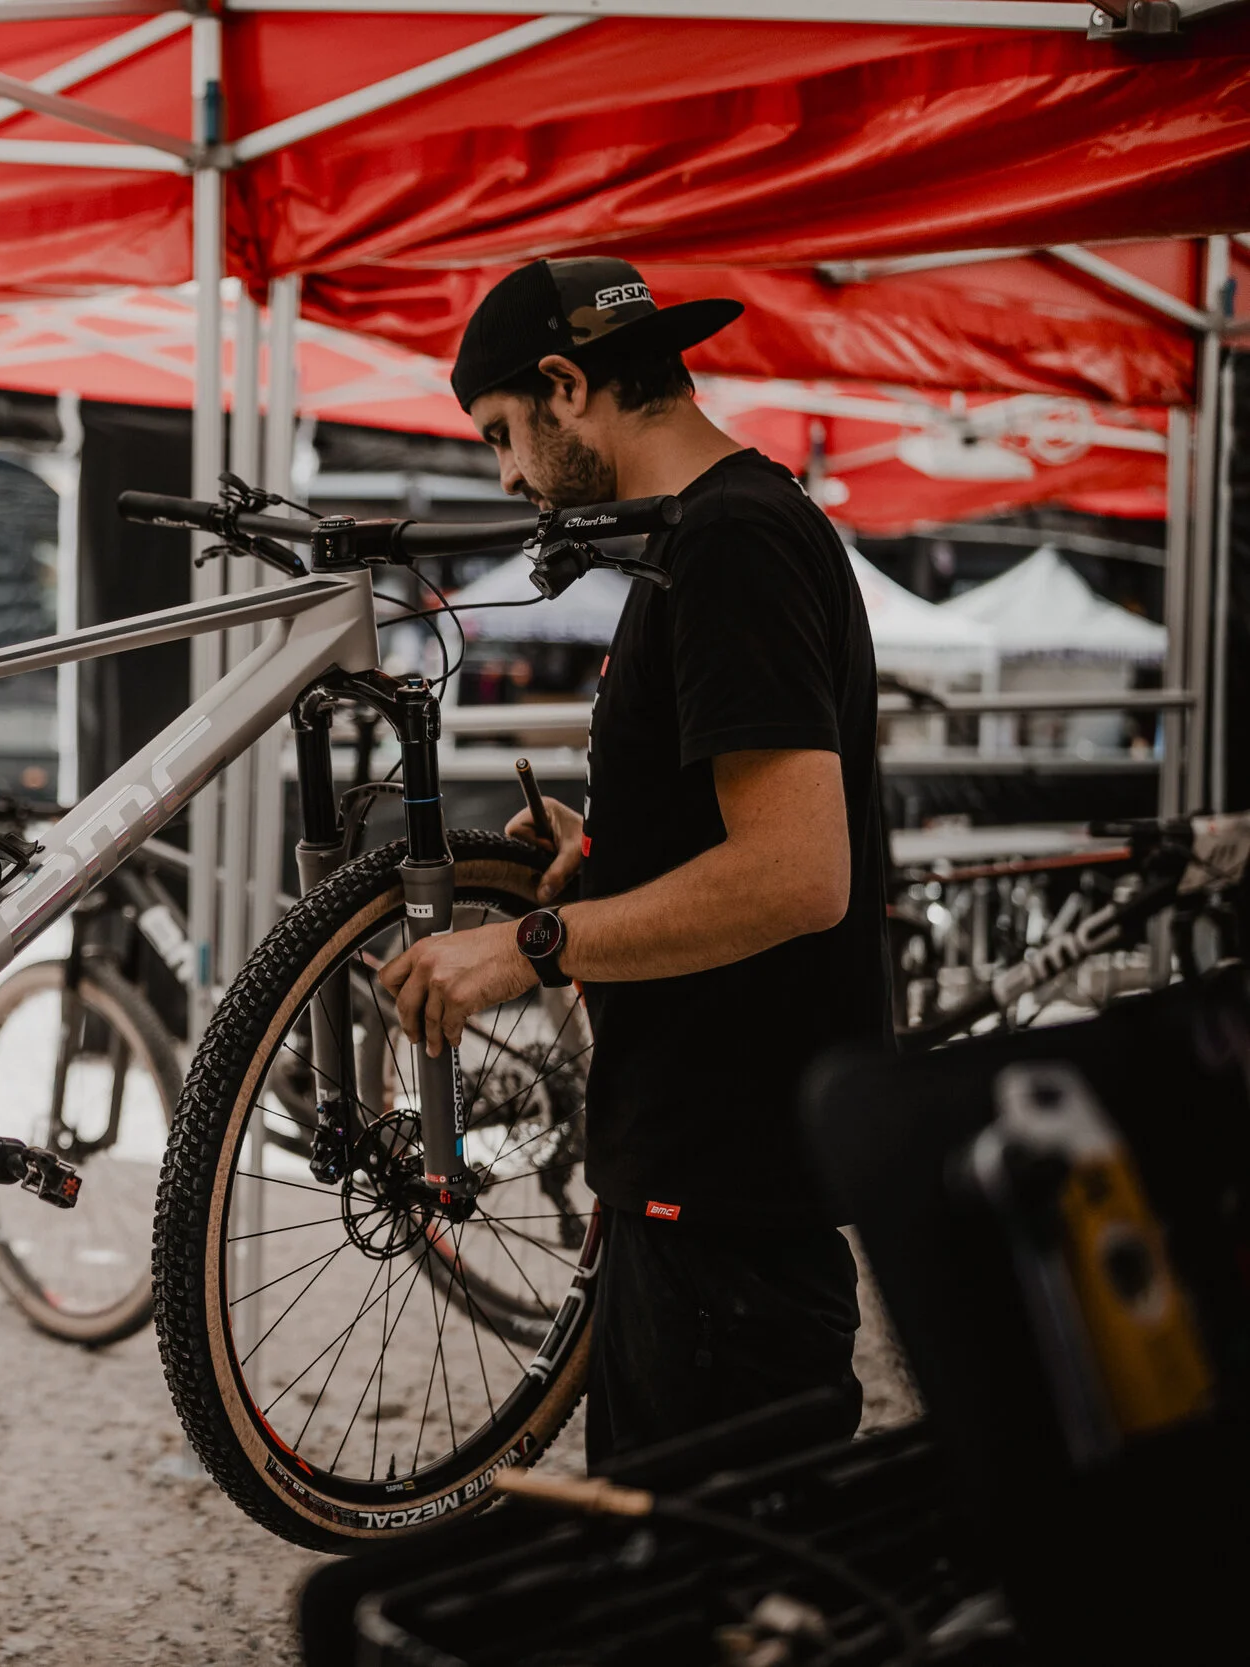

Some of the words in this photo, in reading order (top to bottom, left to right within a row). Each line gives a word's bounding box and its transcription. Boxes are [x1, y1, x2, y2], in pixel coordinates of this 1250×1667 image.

[576, 516, 598, 527] Lizard
[650, 1205, 675, 1216] BMC
[358, 1491, 460, 1529] MEZCAL
